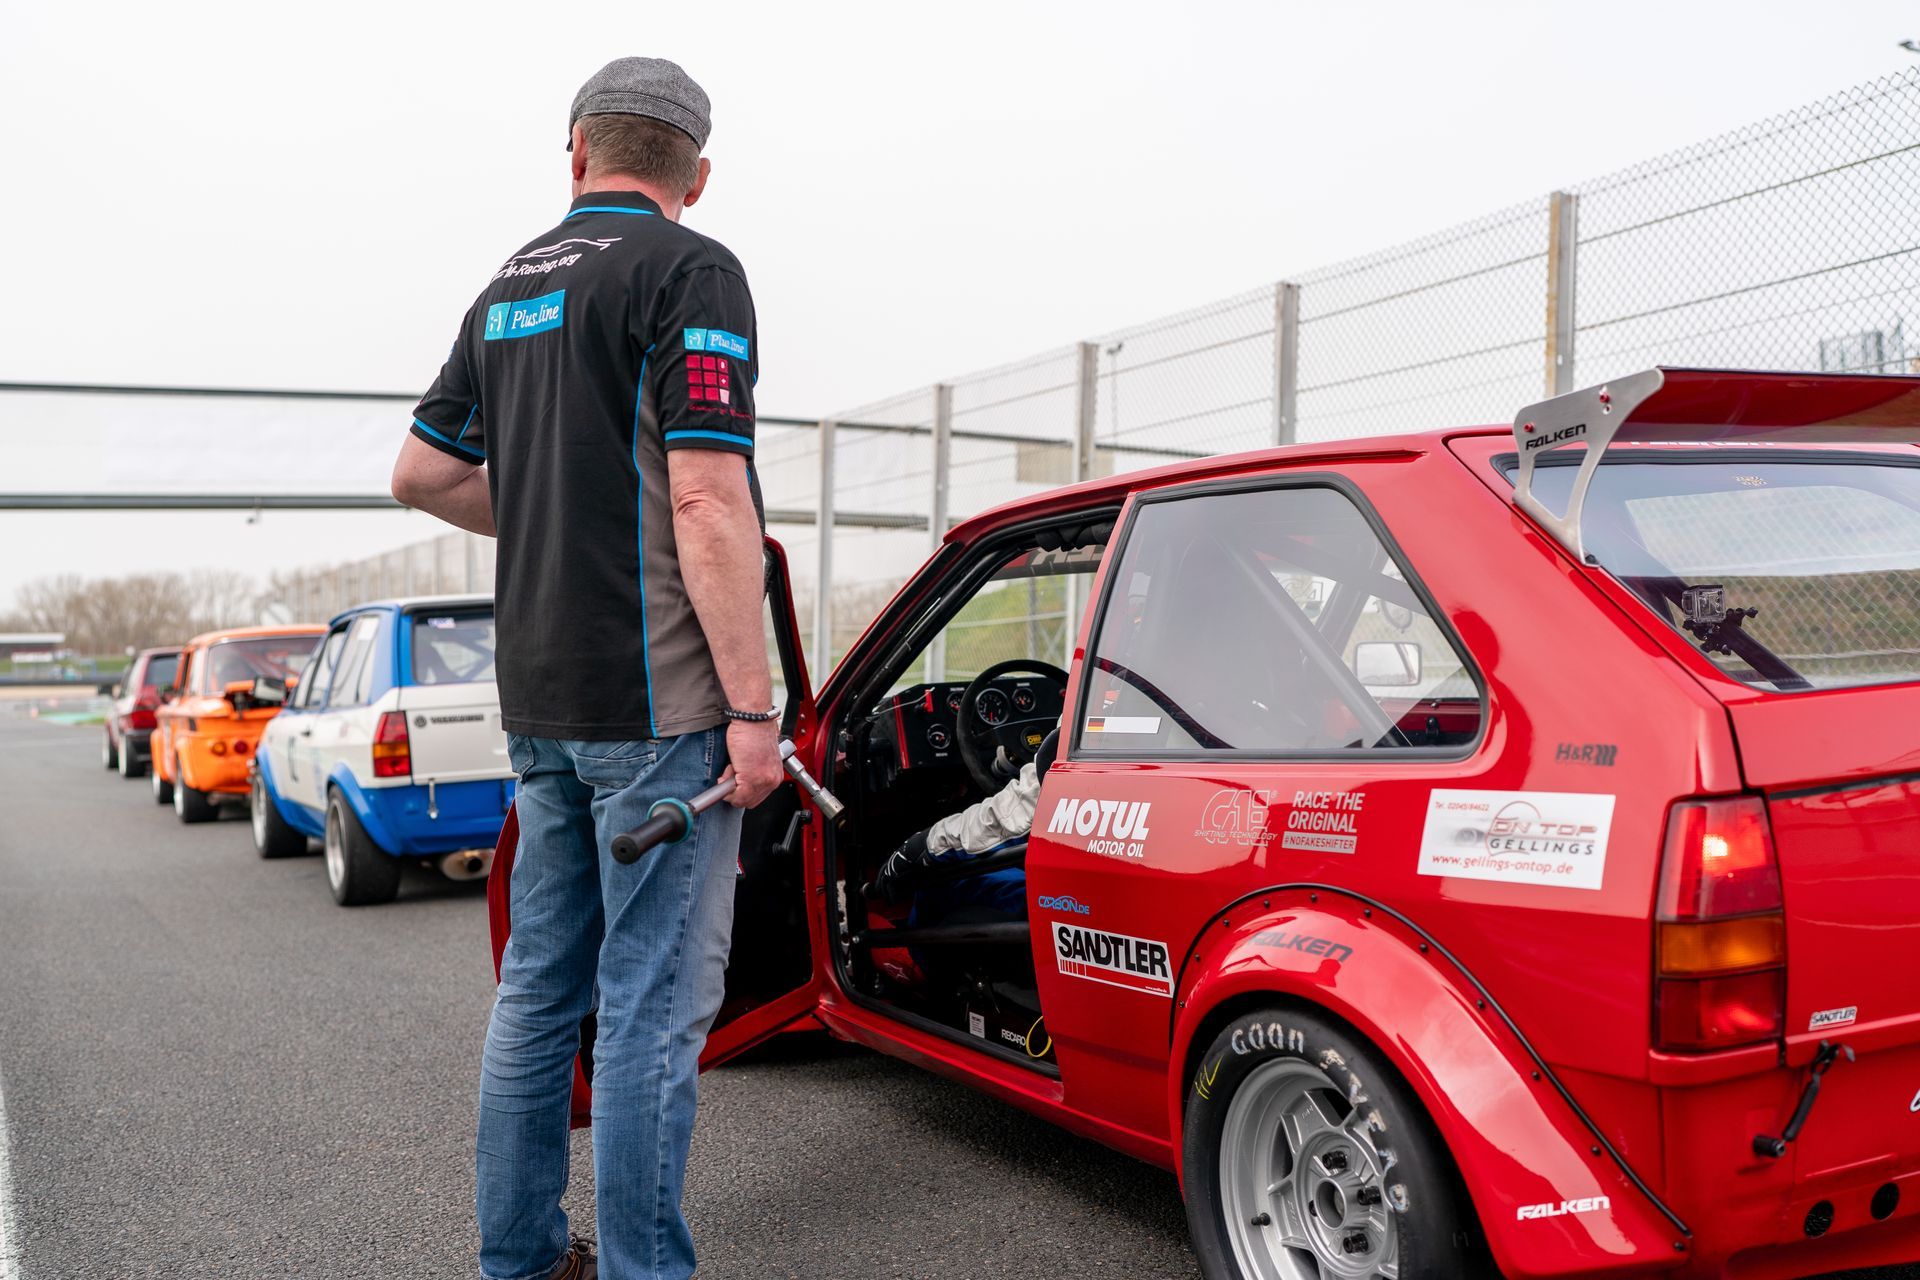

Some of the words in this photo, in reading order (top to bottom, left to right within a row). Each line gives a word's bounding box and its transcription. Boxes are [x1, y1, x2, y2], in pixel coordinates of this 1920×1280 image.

[511, 304, 560, 330] Plus.line
[1526, 424, 1586, 450] FALKEN
[1555, 743, 1595, 763] H&R
[1292, 790, 1330, 809] RACE
[1335, 792, 1366, 811] THE
[1047, 798, 1151, 841] MOTUL
[1288, 811, 1357, 833] ORIGINAL
[1194, 829, 1226, 839] SHIFTING
[1229, 830, 1278, 841] TECHNOLOGY
[1284, 836, 1354, 850] #NOFAKESHIFTER
[1087, 839, 1125, 856] MOTOR
[1127, 842, 1144, 858] OIL
[1490, 838, 1594, 855] GELLINGS
[1432, 853, 1574, 875] www.gellings-ontop.de
[1058, 926, 1168, 978] SANDTLER
[1001, 1028, 1026, 1047] RECARO
[1517, 1195, 1610, 1221] FALKEN
